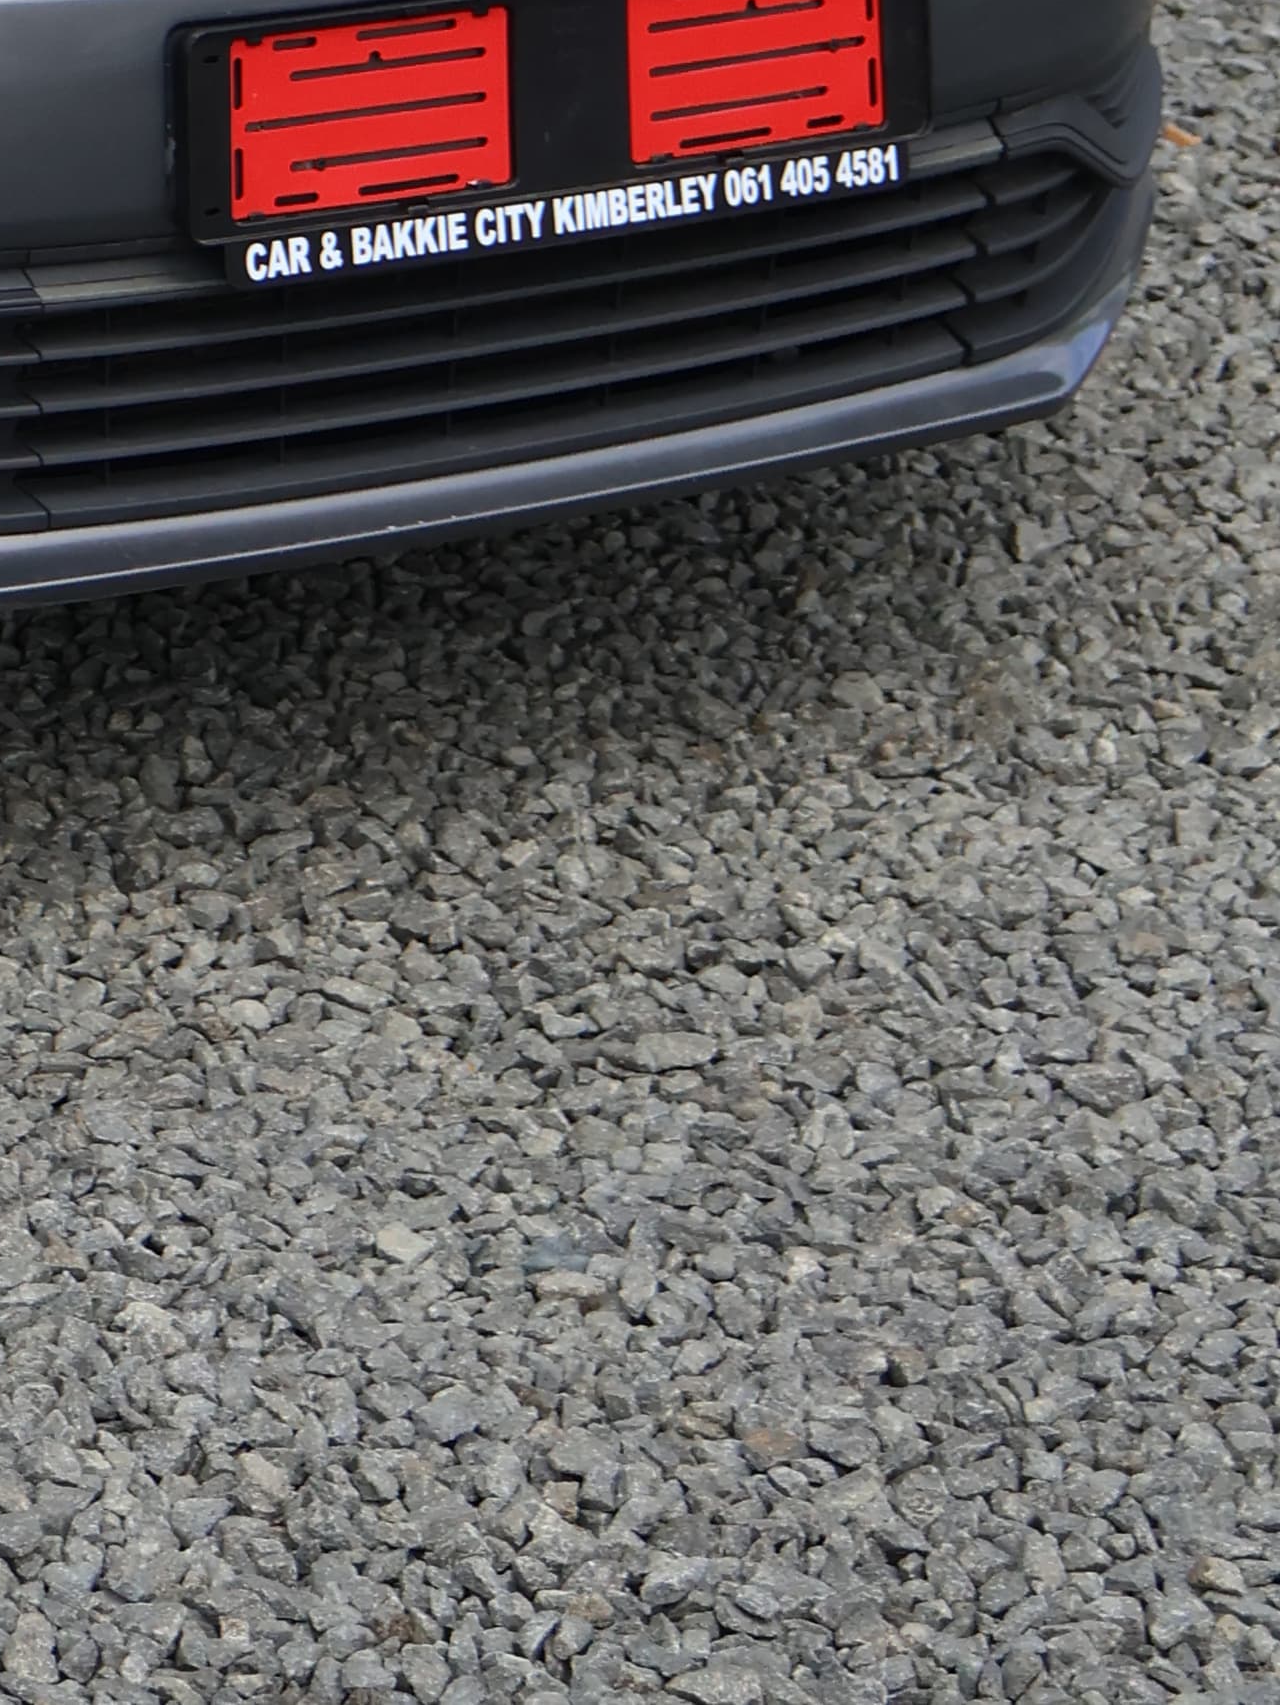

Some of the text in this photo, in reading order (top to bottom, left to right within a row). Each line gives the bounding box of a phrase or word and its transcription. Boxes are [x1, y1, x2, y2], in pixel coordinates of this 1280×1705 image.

[245, 144, 900, 282] CAR & BAKKIE CITY KIMBERLEY 061 405 4581
